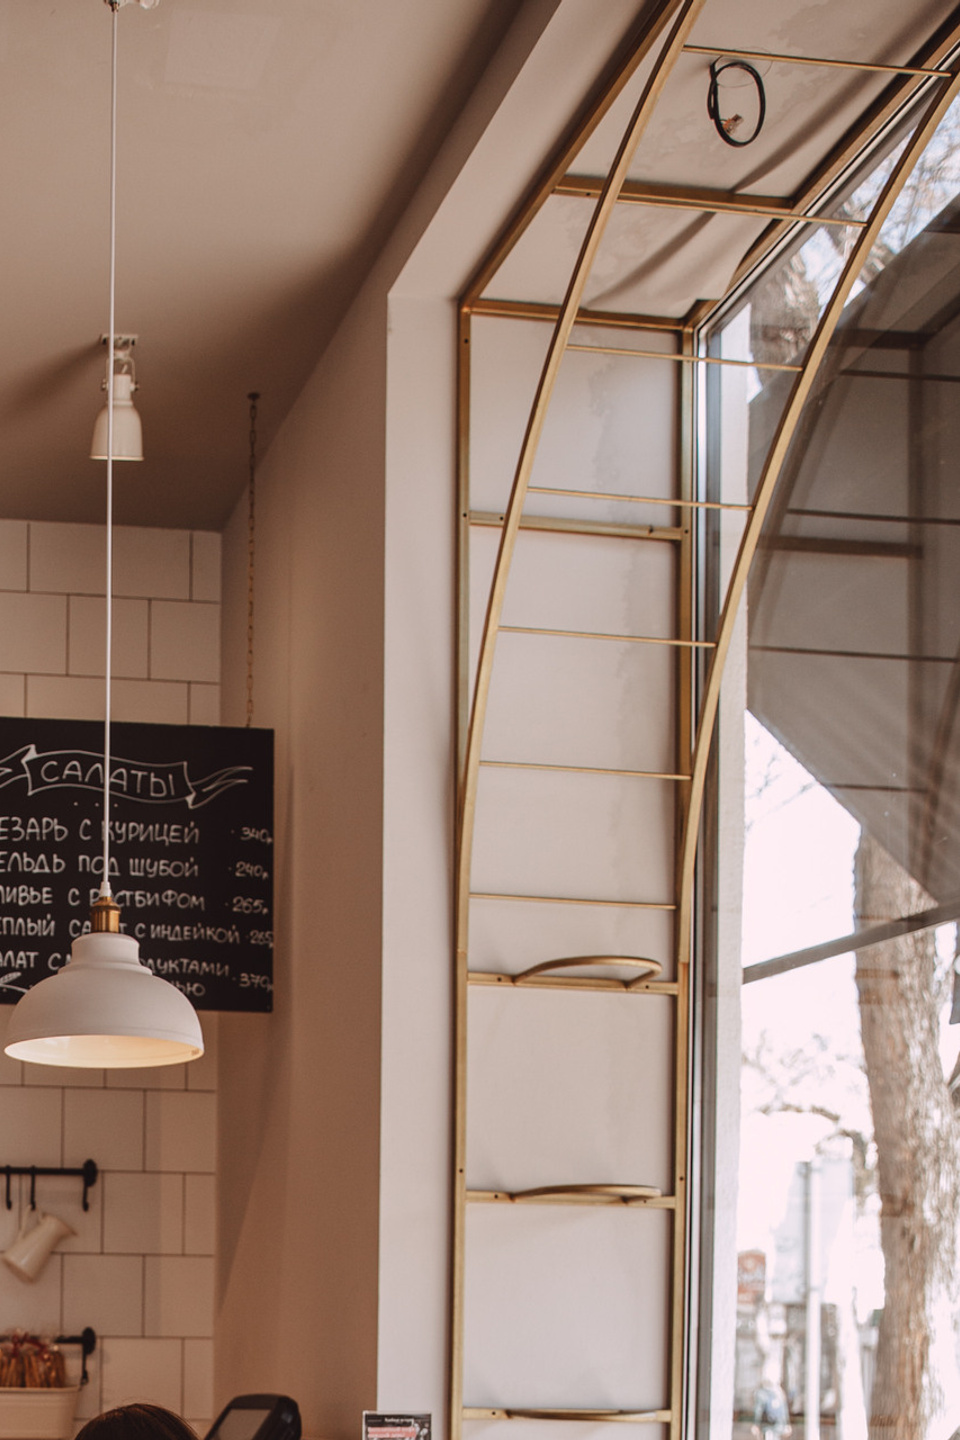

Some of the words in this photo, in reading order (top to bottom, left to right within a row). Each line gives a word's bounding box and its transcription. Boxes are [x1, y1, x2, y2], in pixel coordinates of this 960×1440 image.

[40, 761, 175, 798] САЛАТЫ
[80, 819, 91, 840] С
[101, 821, 198, 845] КУРИЦЕЙ
[79, 855, 119, 877] ПОД
[129, 857, 198, 877] ШУБОЙ
[68, 888, 80, 906] С
[90, 887, 203, 912] РСТБИФОМ
[70, 919, 128, 940] САТ
[135, 923, 145, 938] С
[151, 923, 239, 942] ИНДЕЙКОЙ
[48, 953, 61, 971] С
